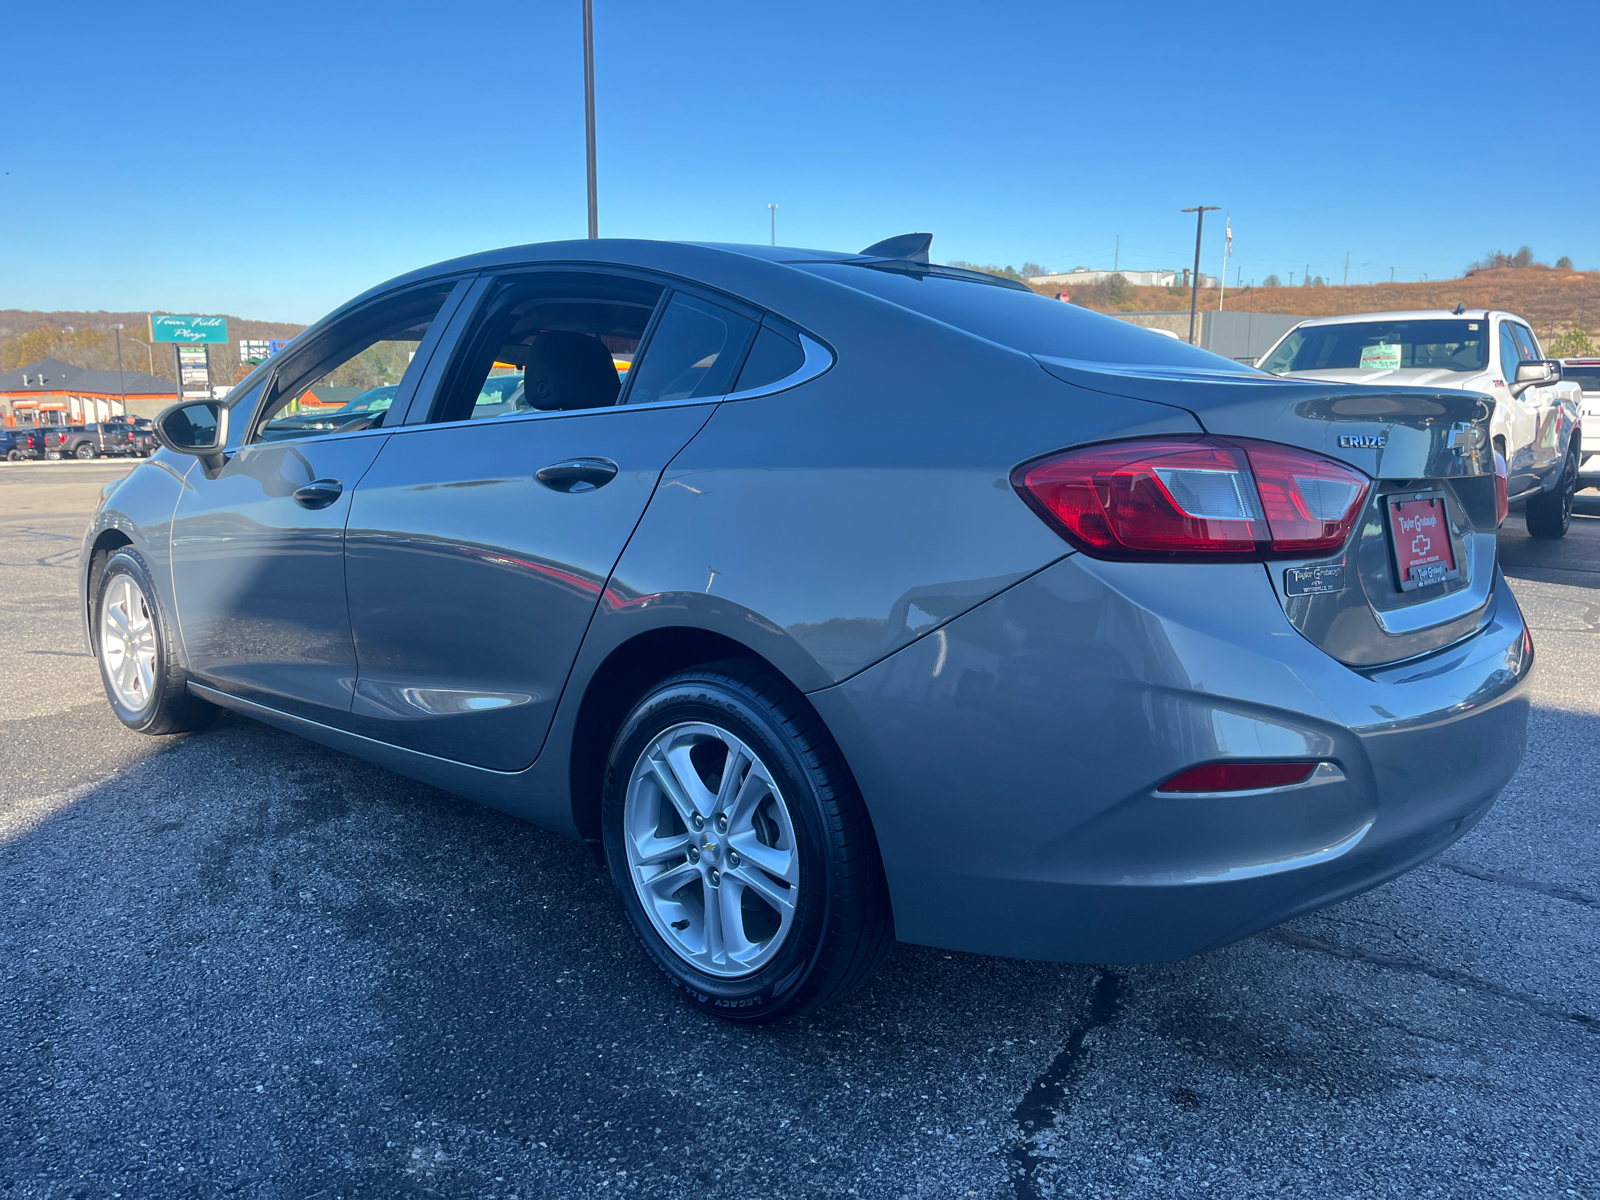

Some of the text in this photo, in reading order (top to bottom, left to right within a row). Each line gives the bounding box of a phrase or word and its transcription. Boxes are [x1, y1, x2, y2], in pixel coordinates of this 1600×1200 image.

[157, 316, 222, 328] Town Field
[1339, 434, 1386, 449] CRUZE
[1398, 516, 1415, 535] Taylor
[1293, 570, 1313, 582] Taylor
[649, 693, 692, 713] LEGACY
[695, 693, 726, 707] ALL
[639, 939, 682, 987] SEASON
[685, 986, 709, 1003] ALL
[714, 995, 761, 1008] LEGACY
